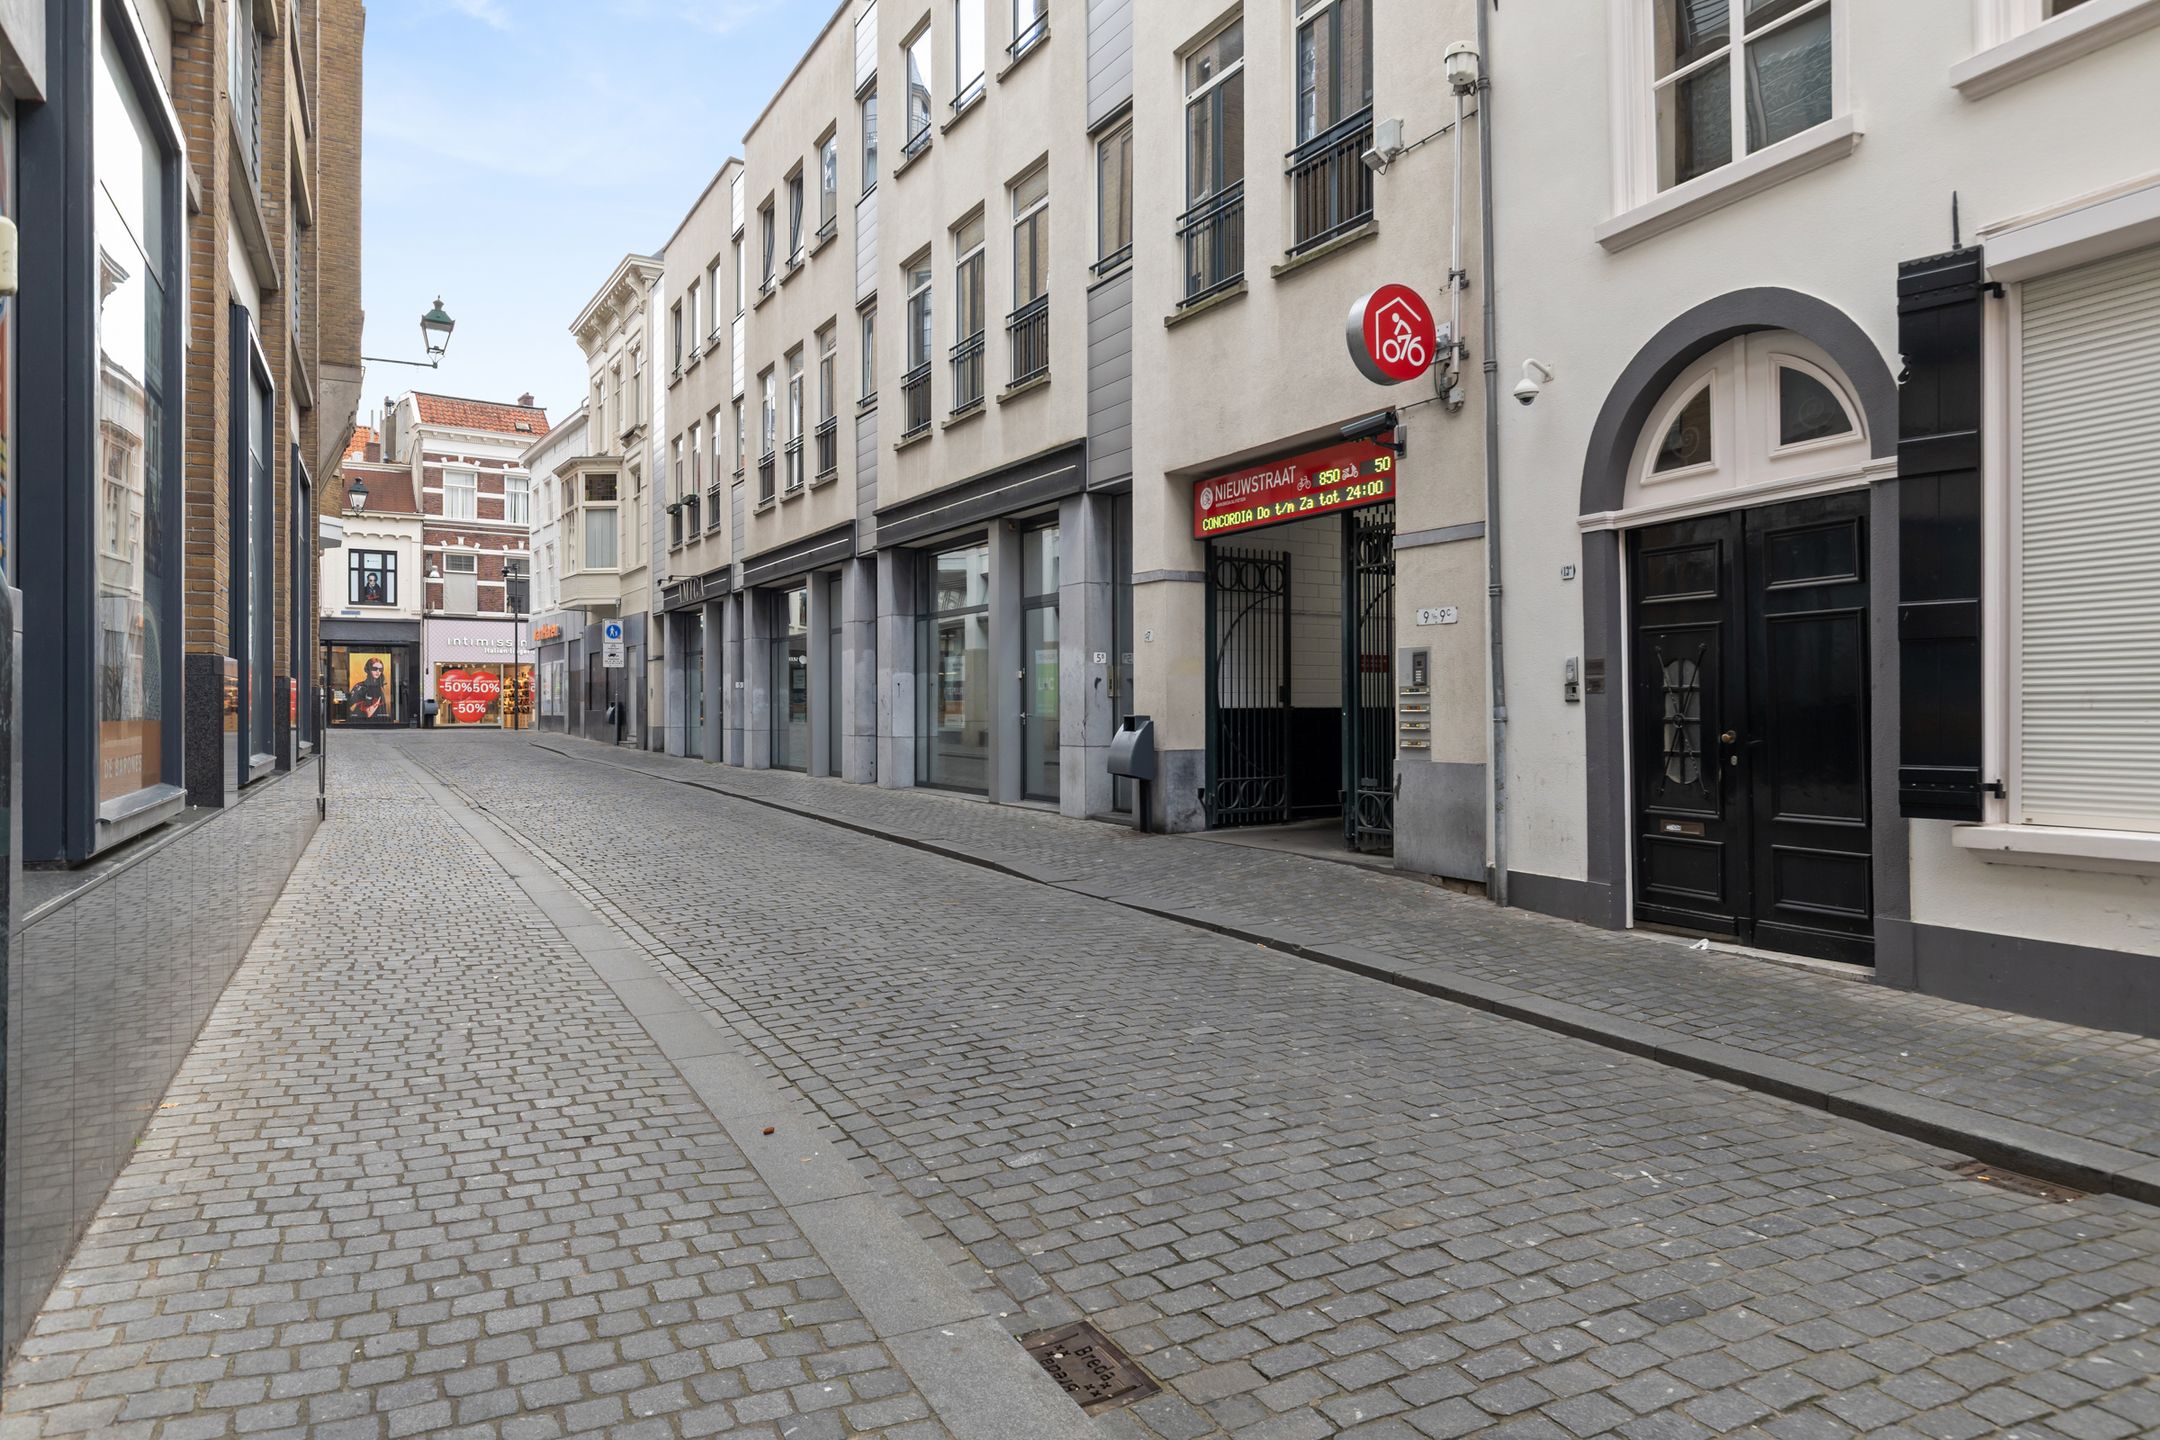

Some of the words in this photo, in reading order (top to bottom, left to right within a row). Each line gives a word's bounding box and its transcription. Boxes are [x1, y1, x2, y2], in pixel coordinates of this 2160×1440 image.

[1382, 333, 1425, 367] 076
[1215, 465, 1296, 501] NIEUWSTRAAT
[1319, 469, 1341, 486] 850
[1375, 456, 1391, 472] 50
[1202, 509, 1253, 531] CONCORDIA
[1257, 506, 1270, 520] Do
[1275, 501, 1295, 516] t/m
[1300, 497, 1314, 511] Za
[1319, 490, 1340, 507] tot
[1346, 480, 1384, 501] 24:00
[1423, 610, 1430, 623] 9
[439, 681, 473, 693] -50%
[453, 703, 486, 714] -50%
[1074, 1345, 1116, 1382] Breda
